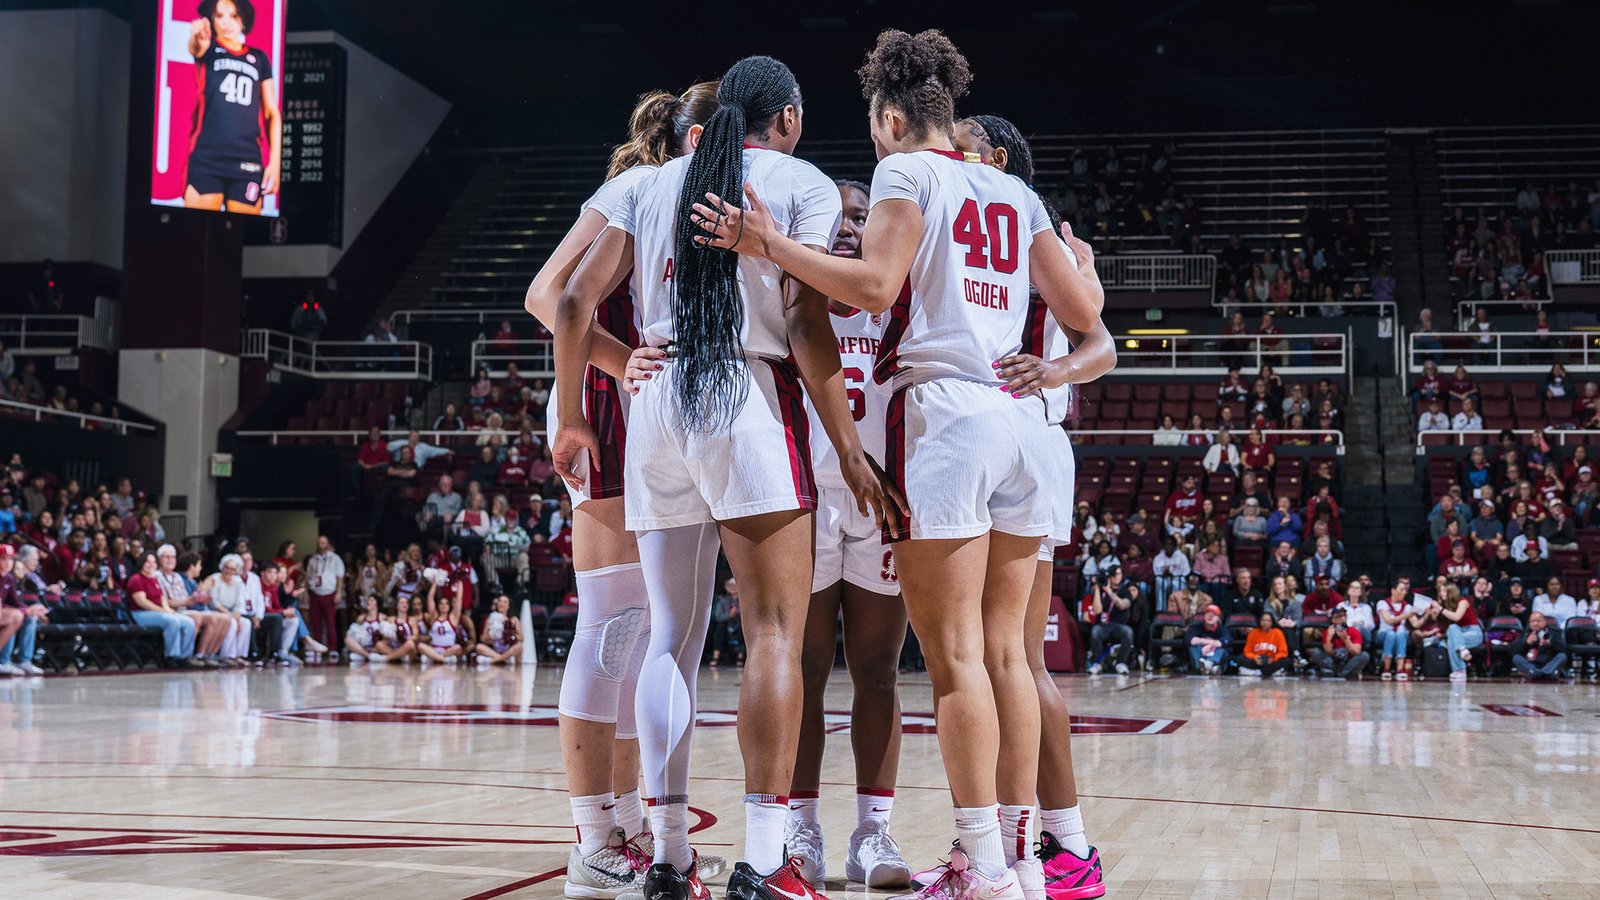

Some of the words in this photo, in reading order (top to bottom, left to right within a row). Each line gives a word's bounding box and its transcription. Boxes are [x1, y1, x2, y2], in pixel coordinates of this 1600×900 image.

[219, 72, 253, 106] 40
[952, 197, 1018, 274] 40
[963, 277, 1009, 311] OGDEN
